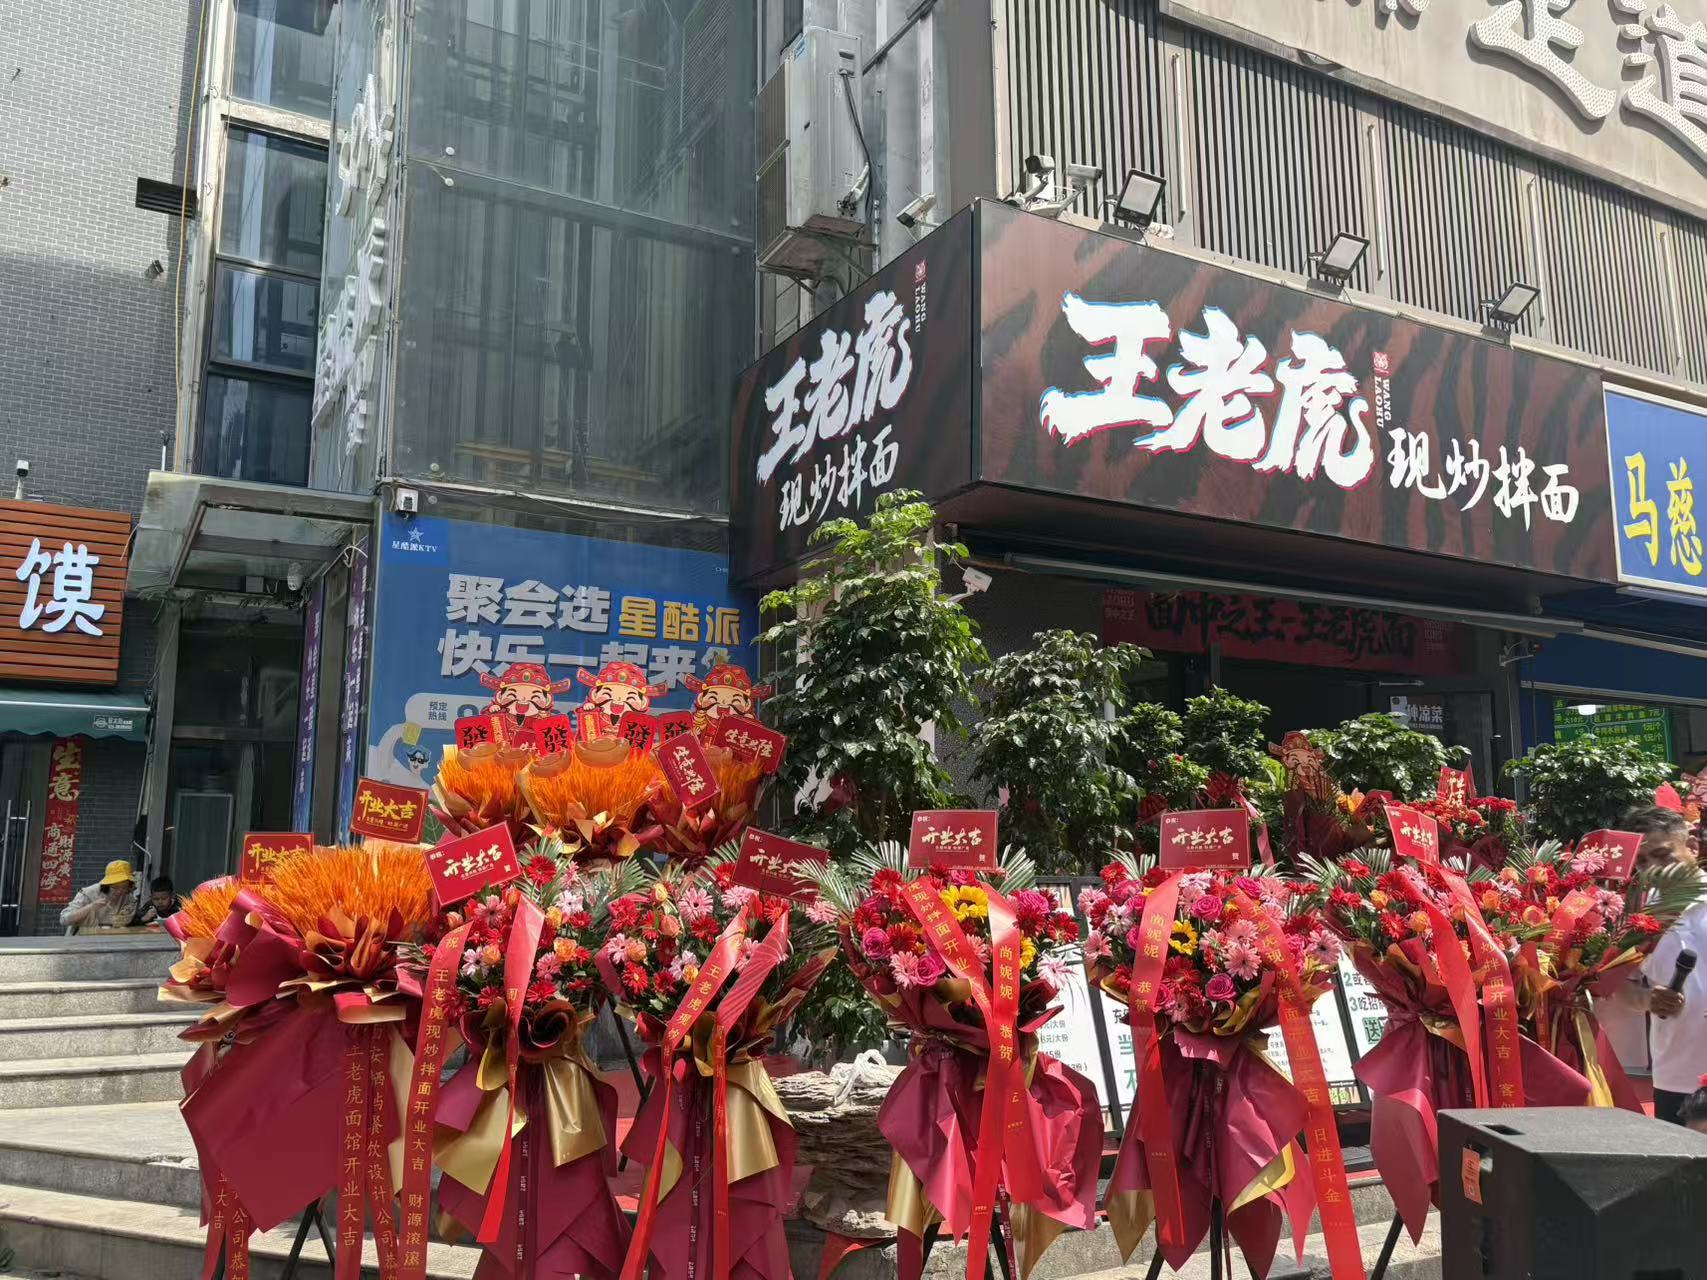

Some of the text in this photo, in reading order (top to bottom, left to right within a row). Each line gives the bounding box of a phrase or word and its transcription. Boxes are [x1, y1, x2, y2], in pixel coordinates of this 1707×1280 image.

[757, 289, 913, 487] 王老虎
[1040, 290, 1375, 489] 王老虎
[1374, 375, 1384, 429] LAOHU
[1382, 378, 1393, 422] WANG
[780, 423, 900, 532] 现炒拌面
[1387, 427, 1581, 532] 现炒拌面
[16, 537, 105, 636] 馍
[428, 711, 447, 721] 热线
[429, 701, 448, 711] 预定
[359, 790, 417, 821] 开业大吉
[921, 825, 983, 847] 开业大吉
[1171, 825, 1234, 846] 开业大吉
[443, 843, 503, 878] 开业大吉
[999, 946, 1014, 1000] 尚妮妮
